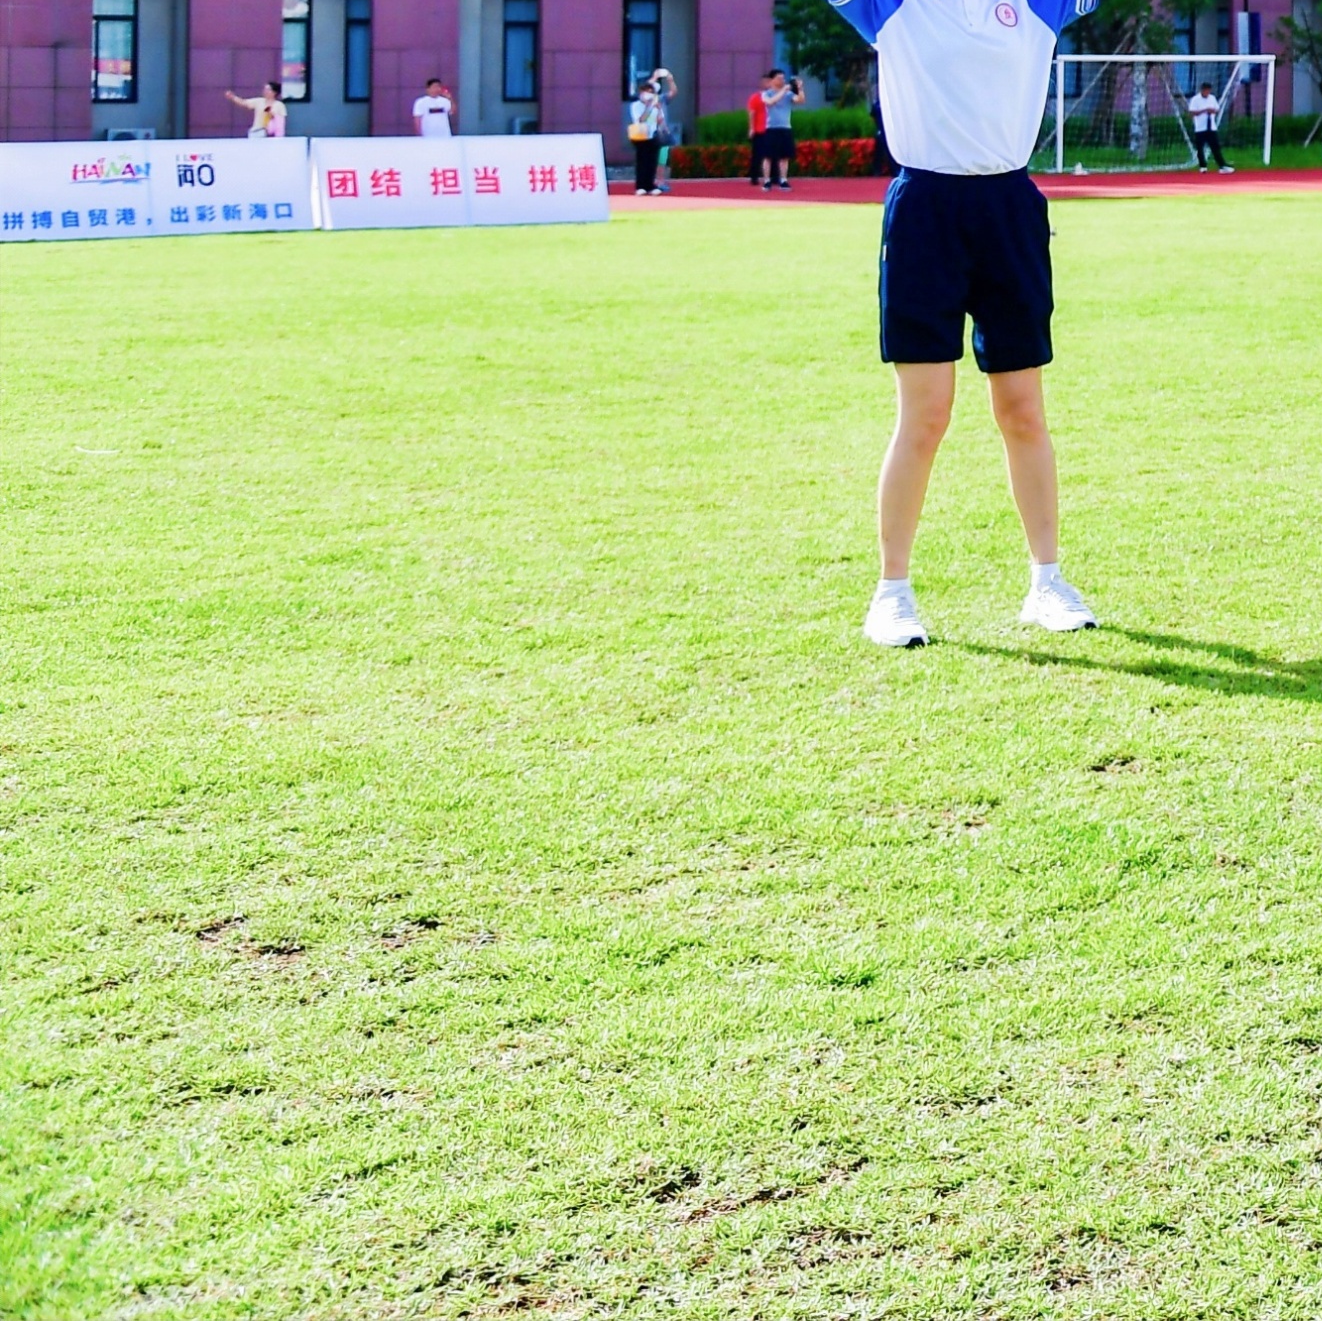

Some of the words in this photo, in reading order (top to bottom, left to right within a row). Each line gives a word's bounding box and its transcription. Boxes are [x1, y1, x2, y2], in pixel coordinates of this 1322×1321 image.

[327, 167, 402, 199] 团结
[430, 166, 501, 195] 担当
[529, 164, 599, 193] 拼搏
